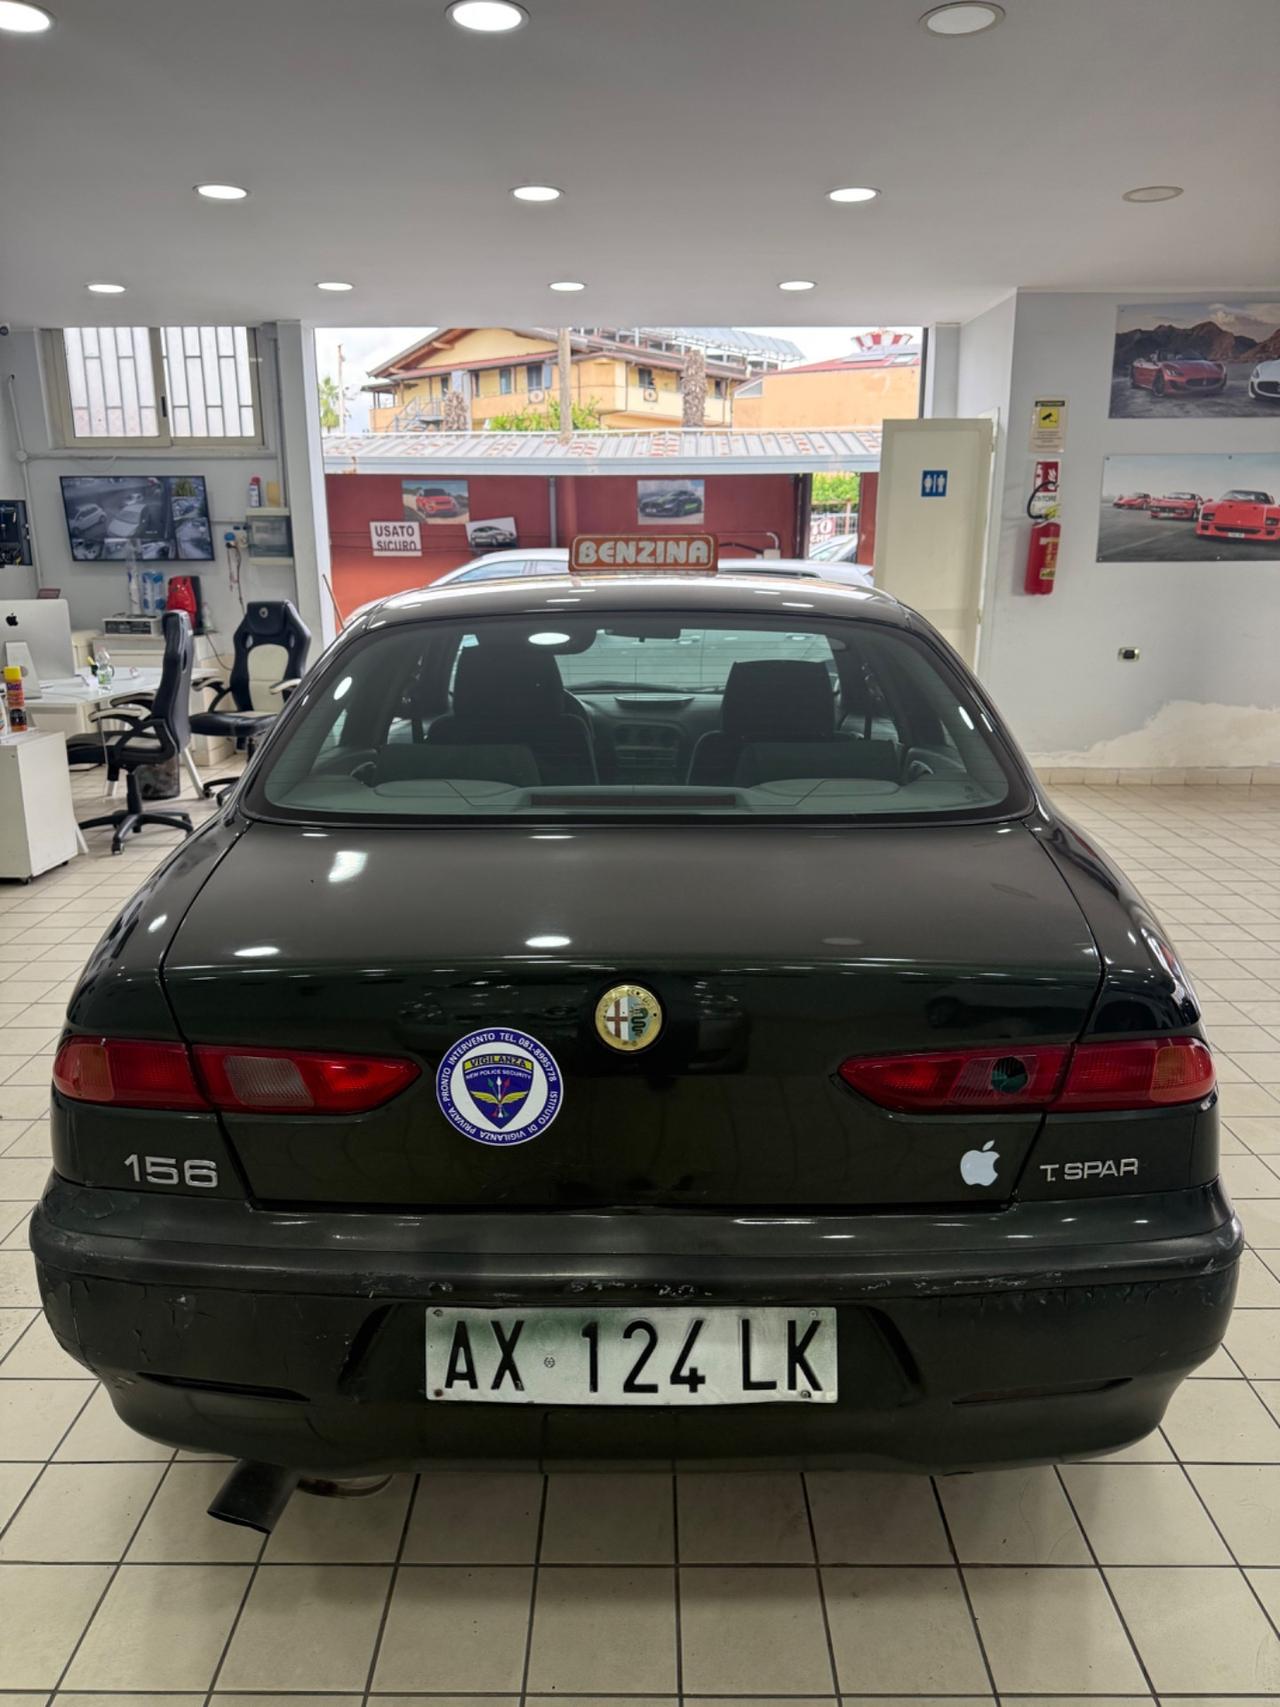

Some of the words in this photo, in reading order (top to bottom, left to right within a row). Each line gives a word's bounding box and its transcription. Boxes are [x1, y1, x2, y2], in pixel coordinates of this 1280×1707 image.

[375, 525, 414, 537] USATO
[376, 540, 417, 552] SICURO
[578, 540, 709, 564] BENZINA
[500, 1032, 517, 1042] TEL.
[448, 1032, 496, 1065] INTERVENTO
[470, 1055, 526, 1067] VIGILANZA
[440, 1067, 451, 1102] PRONTO
[502, 1069, 532, 1079] SECURITY
[538, 1091, 558, 1124] ISTITUTO
[448, 1107, 477, 1134] PRIVATA
[527, 1124, 538, 1134] DI
[479, 1129, 526, 1141] VIGILANZA
[124, 1153, 218, 1188] 156
[1064, 1158, 1139, 1180] SPAR
[445, 1319, 525, 1391] AX
[581, 1319, 706, 1394] 124
[740, 1319, 823, 1392] LK
